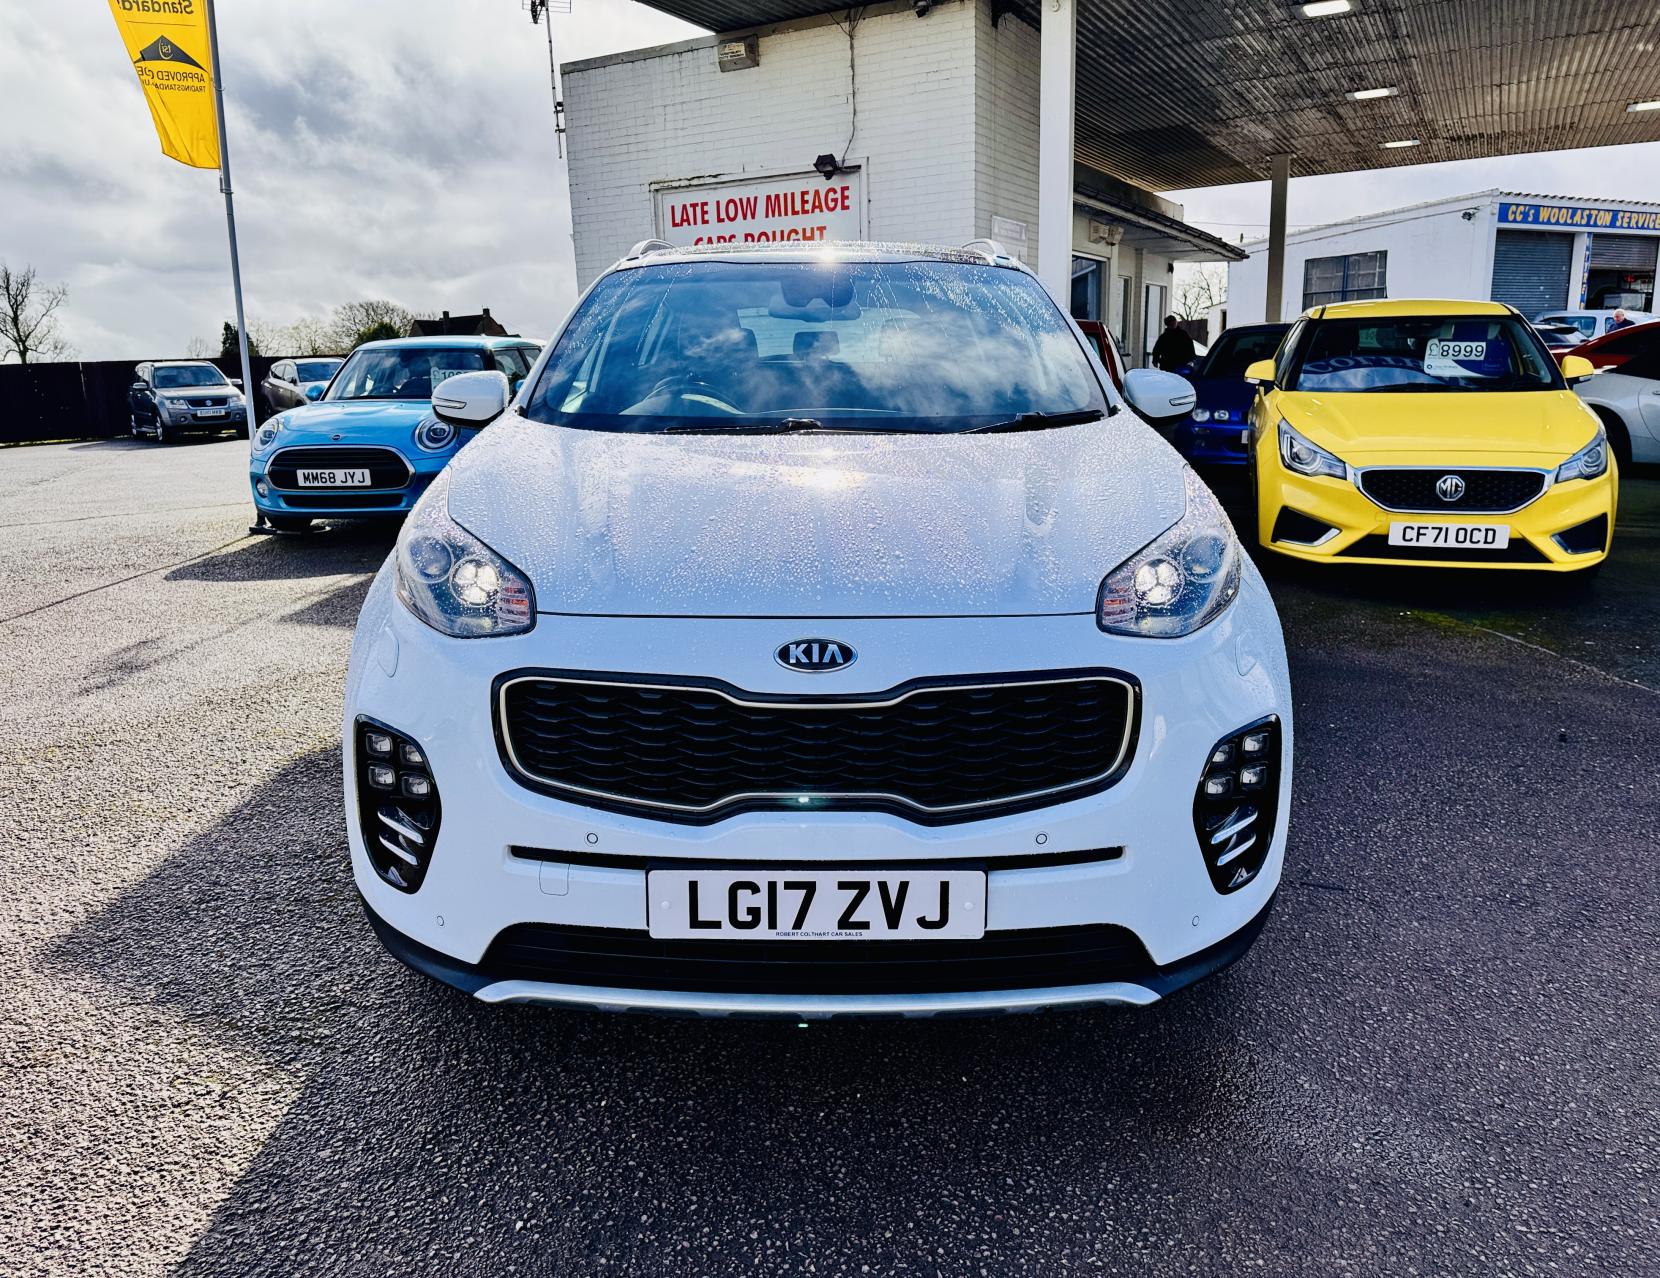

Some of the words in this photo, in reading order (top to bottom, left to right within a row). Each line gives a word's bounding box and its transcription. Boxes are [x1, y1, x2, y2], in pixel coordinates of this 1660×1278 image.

[671, 202, 709, 228] LATE
[716, 196, 758, 223] LOW
[765, 186, 850, 218] MILEAGE
[1508, 205, 1535, 221] CC's
[1539, 207, 1613, 226] WOOLASTON
[303, 472, 336, 485] MM68
[340, 471, 367, 484] JYJ
[1440, 477, 1463, 499] MG
[1402, 526, 1449, 544] CF71
[1455, 528, 1496, 544] OCD
[788, 643, 844, 664] KIA
[688, 880, 817, 930] LG17
[837, 880, 950, 930] ZVJ
